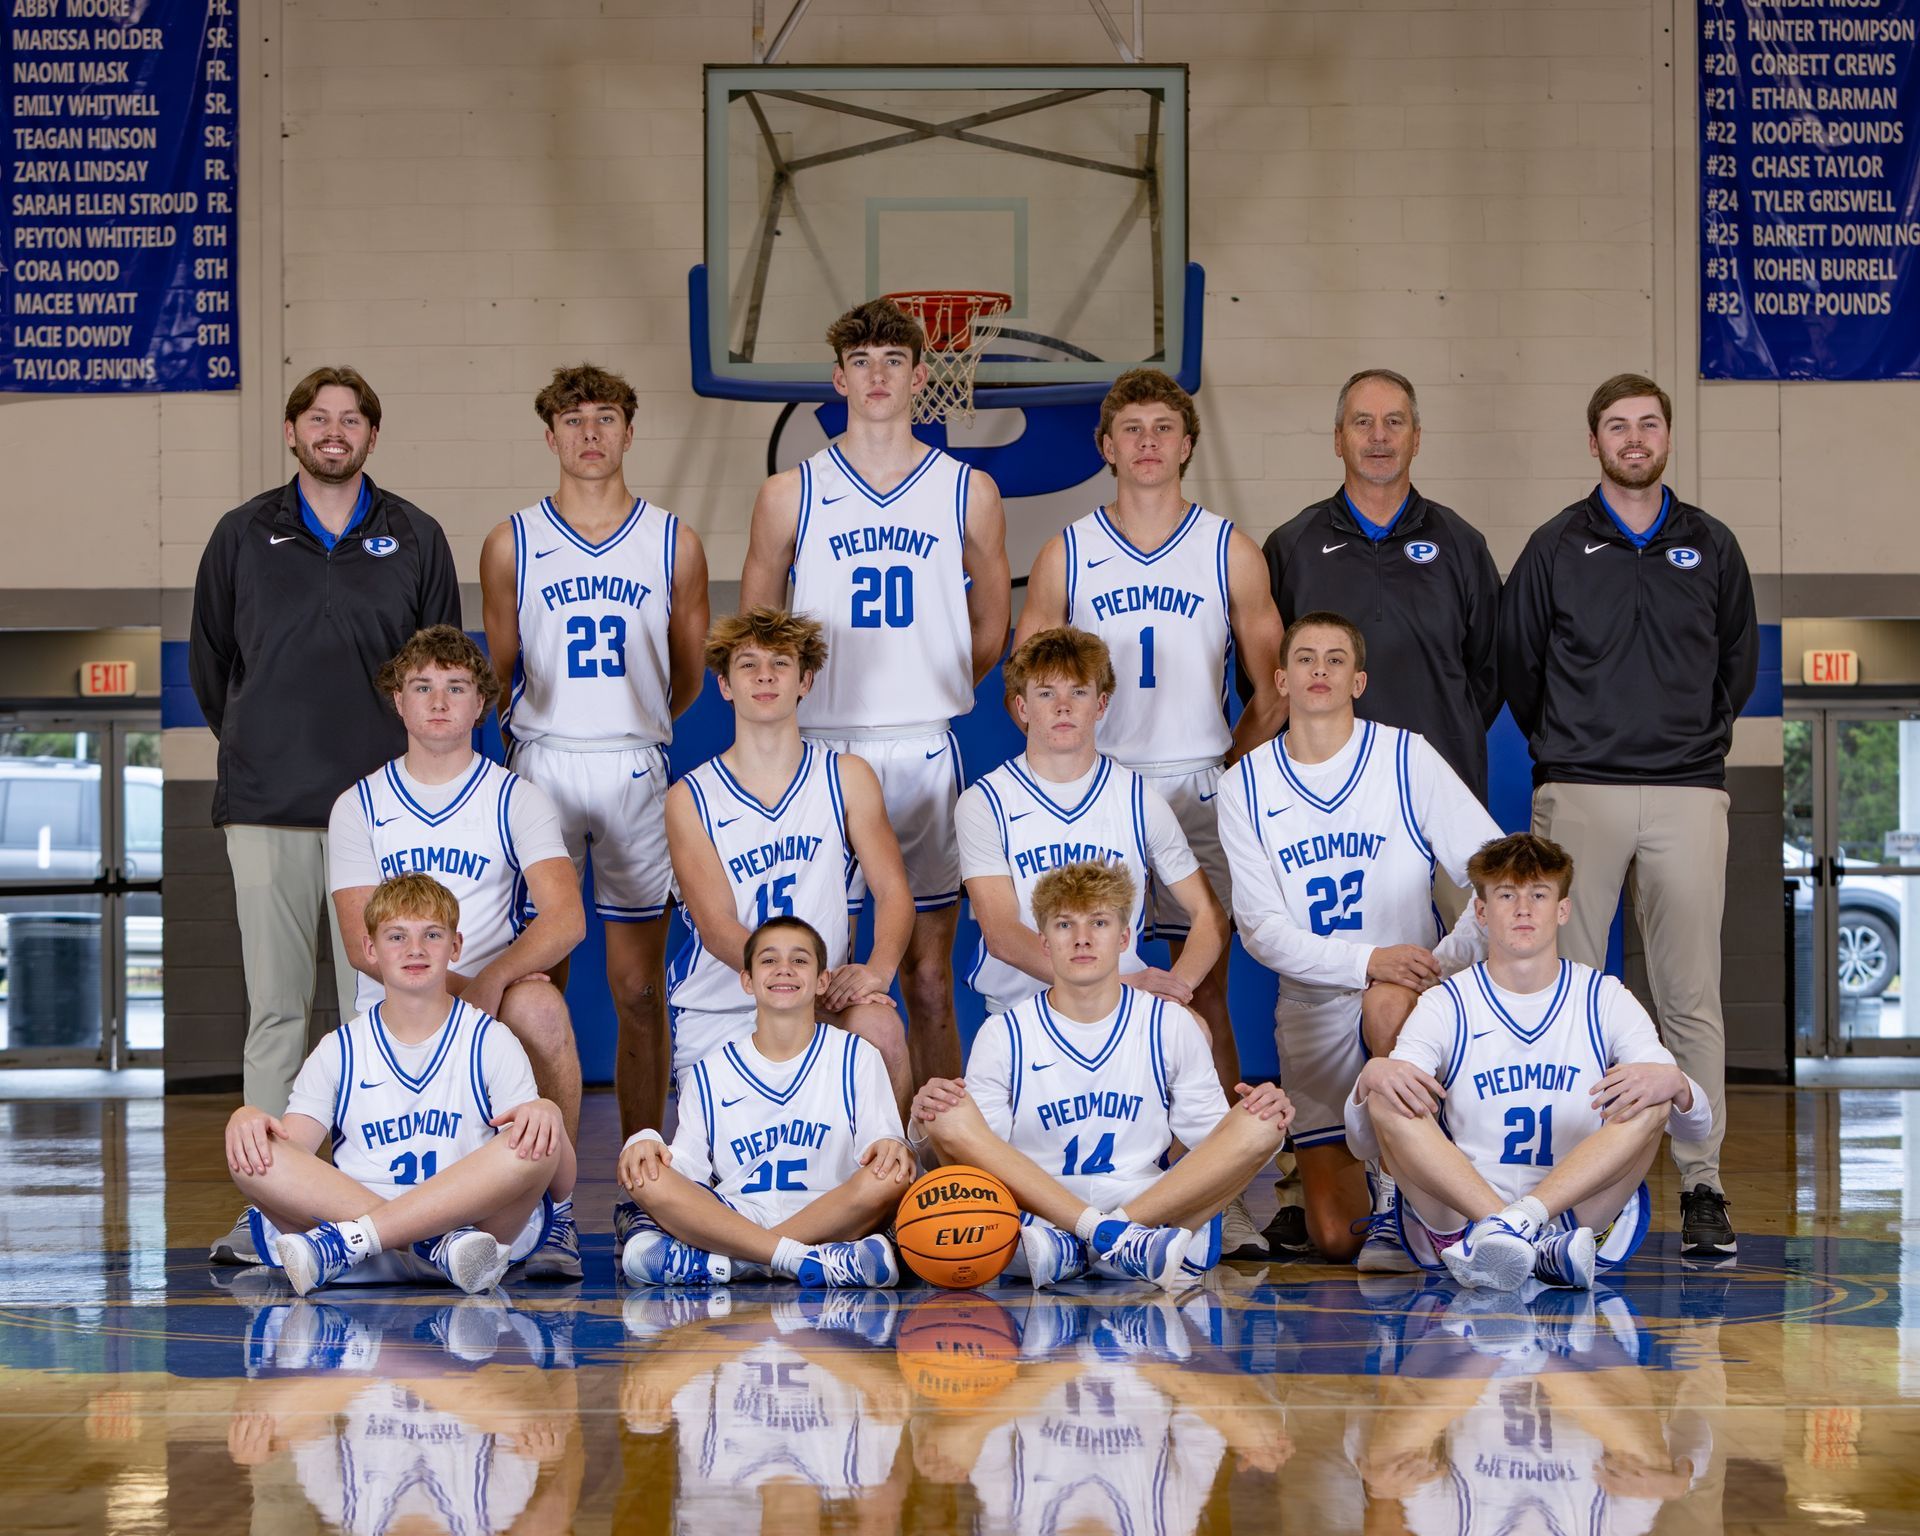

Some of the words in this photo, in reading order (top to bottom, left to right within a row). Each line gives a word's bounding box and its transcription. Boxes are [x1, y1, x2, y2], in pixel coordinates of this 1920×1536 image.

[12, 0, 58, 17] ABBY
[66, 0, 129, 17] MOORE
[209, 0, 232, 16] FR.
[12, 30, 90, 50] MARISSA
[95, 29, 163, 49] HOLDER
[207, 28, 232, 48] SR.
[1704, 19, 1736, 41] #15
[1748, 20, 1815, 41] HUNTER
[1819, 19, 1915, 42] THOMPSON
[13, 63, 74, 83] NAOMI
[79, 62, 128, 83] MASK
[207, 61, 231, 81] FR.
[1705, 54, 1737, 76] #20
[1751, 54, 1830, 76] CORBETT
[1834, 53, 1896, 76] CREWS
[13, 96, 64, 116] EMILY
[68, 95, 159, 116] WHITWELL
[205, 93, 231, 114] SR.
[1705, 88, 1735, 110] #21
[1752, 88, 1812, 110] ETHAN
[1817, 87, 1897, 110] BARMAN
[13, 129, 82, 149] TEAGAN
[88, 128, 156, 149] HINSON
[204, 126, 231, 147] SR.
[1706, 122, 1737, 144] #22
[1752, 122, 1824, 144] KOOPER
[1828, 121, 1904, 144] POUNDS
[13, 162, 70, 182] ZARYA
[75, 161, 148, 182] LINDSAY
[205, 160, 230, 180] FR.
[1707, 156, 1737, 177] #23
[1752, 156, 1810, 178] CHASE
[1814, 156, 1884, 178] TAYLOR
[12, 195, 71, 216] SARAH
[76, 194, 125, 215] ELLEN
[130, 192, 198, 215] STROUD
[208, 193, 232, 213] FR.
[1707, 189, 1739, 211] #24
[1752, 190, 1806, 212] TYLER
[1809, 190, 1896, 212] GRISWELL
[15, 228, 81, 248] PEYTON
[86, 226, 176, 248] WHITFIELD
[193, 226, 227, 247] 8TH
[1707, 223, 1739, 245] #25
[1753, 224, 1827, 247] BARRETT
[1831, 223, 1920, 247] DOWNING
[15, 261, 62, 282] CORA
[67, 261, 119, 281] HOOD
[194, 259, 228, 279] 8TH
[1707, 258, 1739, 280] #31
[1754, 258, 1816, 281] KOHEN
[1821, 258, 1898, 280] BURRELL
[15, 294, 73, 314] MACEE
[77, 293, 138, 314] WYATT
[196, 292, 229, 312] 8TH
[1707, 292, 1739, 314] #32
[1755, 292, 1812, 315] KOLBY
[1816, 292, 1891, 315] POUNDS
[15, 327, 62, 348] LACIE
[66, 326, 132, 347] DOWDY
[198, 324, 230, 345] 8TH
[13, 359, 82, 380] TAYLOR
[84, 359, 155, 380] JENKINS
[208, 358, 235, 378] SO.
[829, 526, 940, 561] PIEDMONT
[541, 575, 652, 612] PIEDMONT
[851, 565, 914, 628] 20
[1091, 585, 1205, 622] PIEDMONT
[567, 615, 627, 678] 23
[1139, 626, 1156, 688] 1
[91, 664, 128, 693] EXIT
[1813, 653, 1850, 682] EXIT
[380, 846, 491, 882] PIEDMONT
[728, 835, 823, 884] PIEDMONT
[1278, 832, 1387, 874] PIEDMONT
[755, 873, 797, 929] 15
[1306, 869, 1365, 936] 22
[1473, 1063, 1581, 1100] PIEDMONT
[1037, 1091, 1143, 1131] PIEDMONT
[361, 1108, 463, 1150] PIEDMONT
[1499, 1104, 1554, 1166] 21
[730, 1119, 831, 1166] PIEDMONT
[1062, 1133, 1116, 1176] 14
[916, 1182, 999, 1210] Wilson
